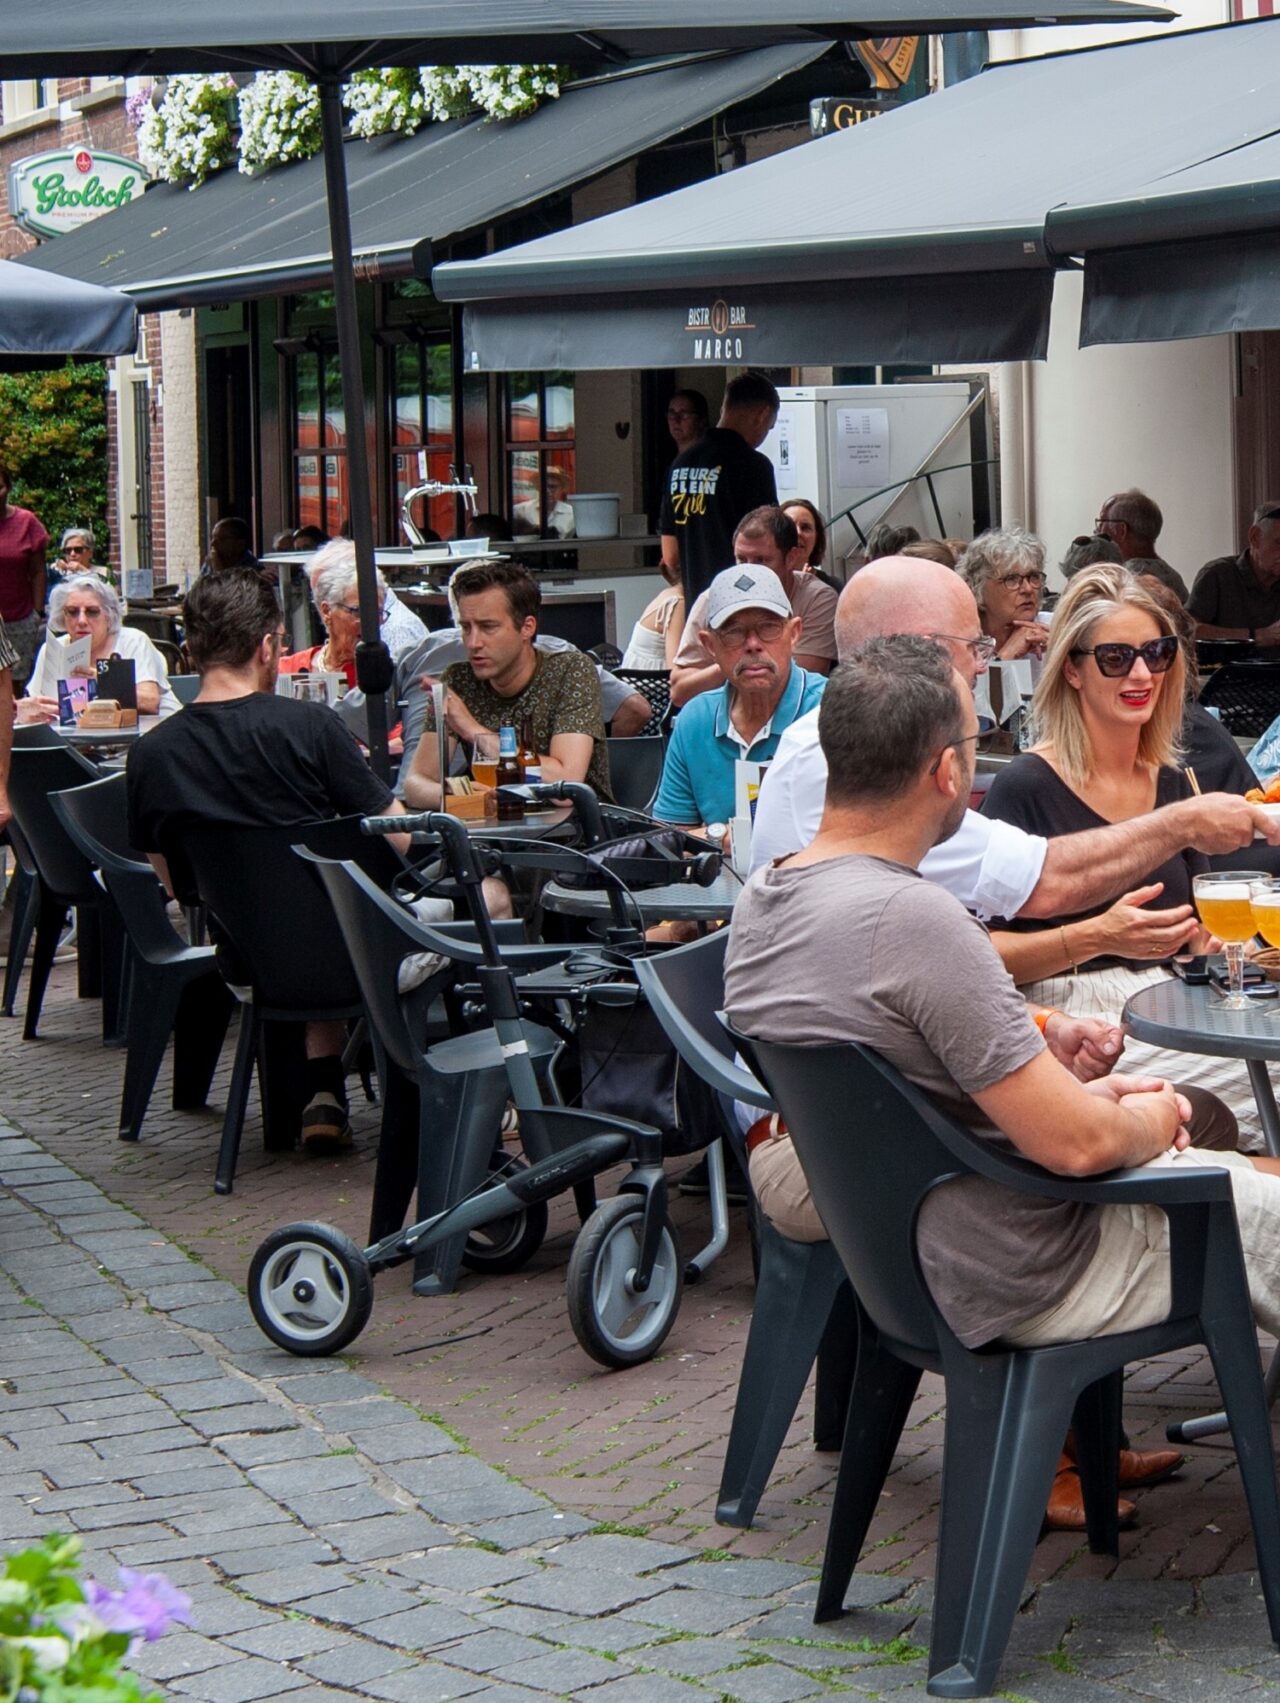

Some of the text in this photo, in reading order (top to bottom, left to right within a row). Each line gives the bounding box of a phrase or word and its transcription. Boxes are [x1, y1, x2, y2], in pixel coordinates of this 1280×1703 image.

[32, 173, 136, 214] Grolsch
[730, 306, 746, 324] BAR
[694, 338, 742, 359] MARCO
[671, 466, 719, 481] BEURS
[670, 481, 716, 495] PLEIN
[97, 660, 109, 674] 35
